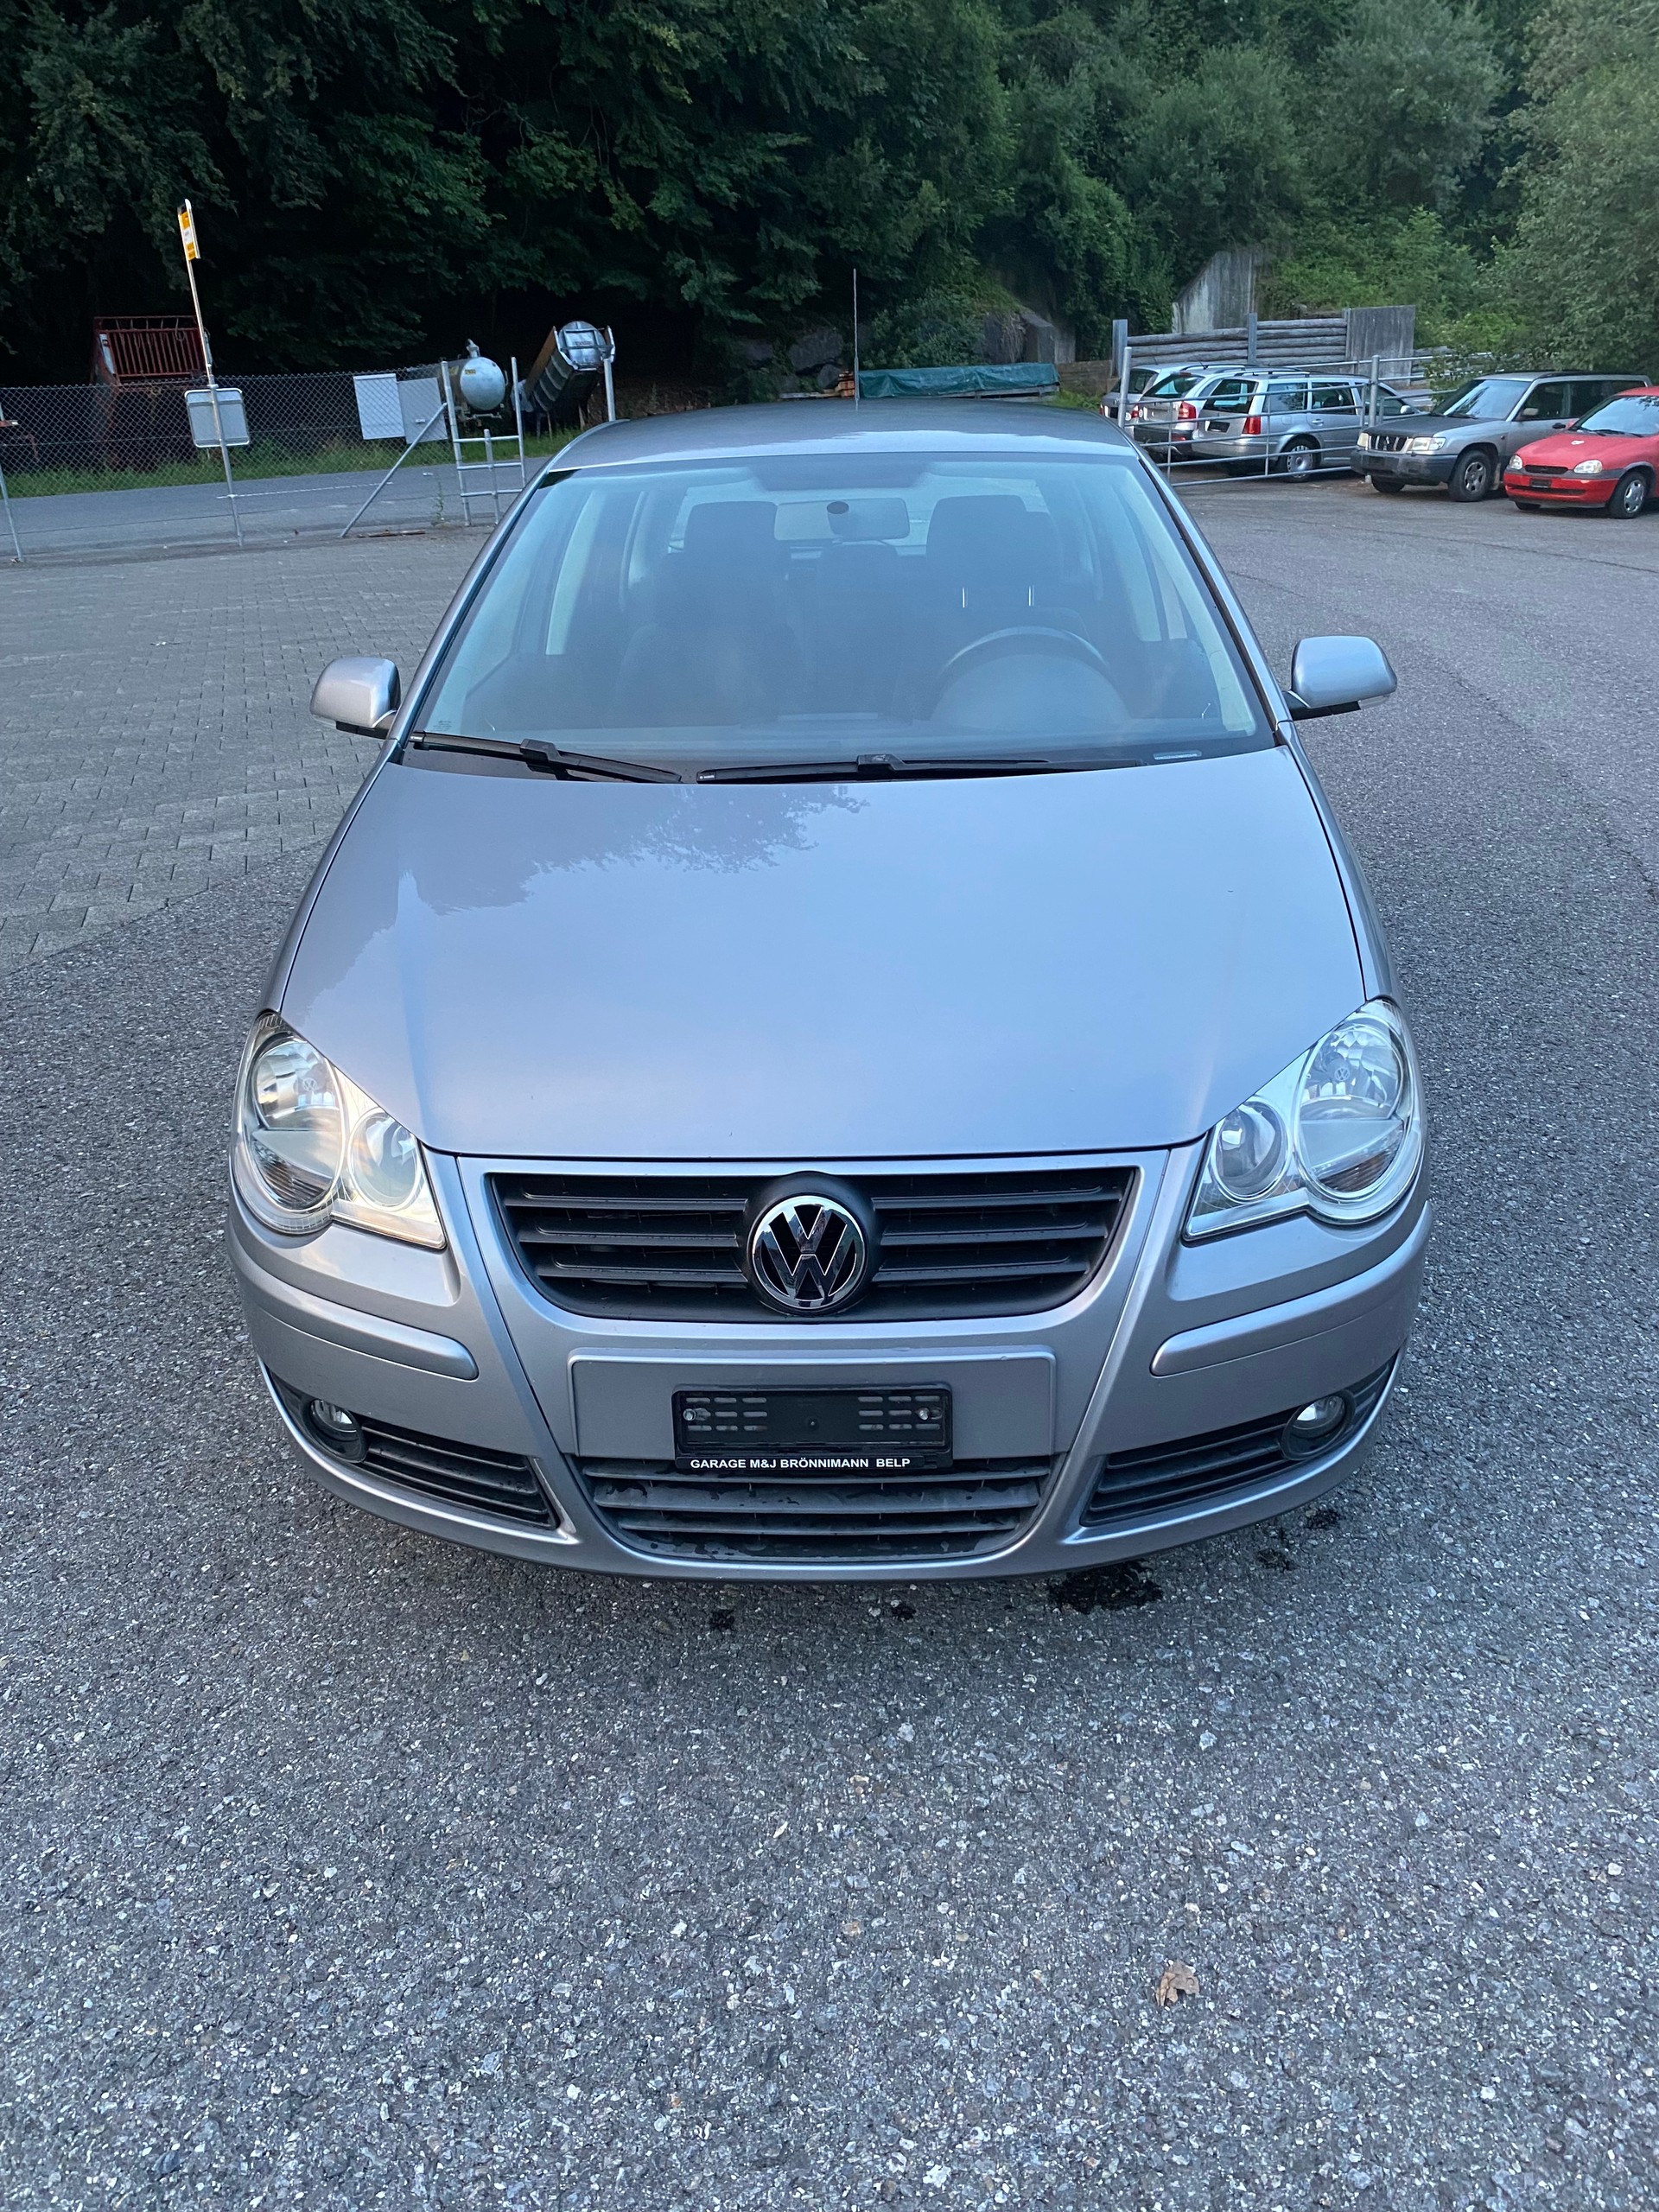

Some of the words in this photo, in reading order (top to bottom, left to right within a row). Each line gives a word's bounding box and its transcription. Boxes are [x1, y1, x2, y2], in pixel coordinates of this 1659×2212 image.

[754, 1197, 863, 1307] VW
[690, 1459, 747, 1469] GARAGE
[749, 1459, 777, 1468] M&J
[779, 1457, 869, 1468] BRÖNNIMANN
[875, 1458, 911, 1467] BELP
